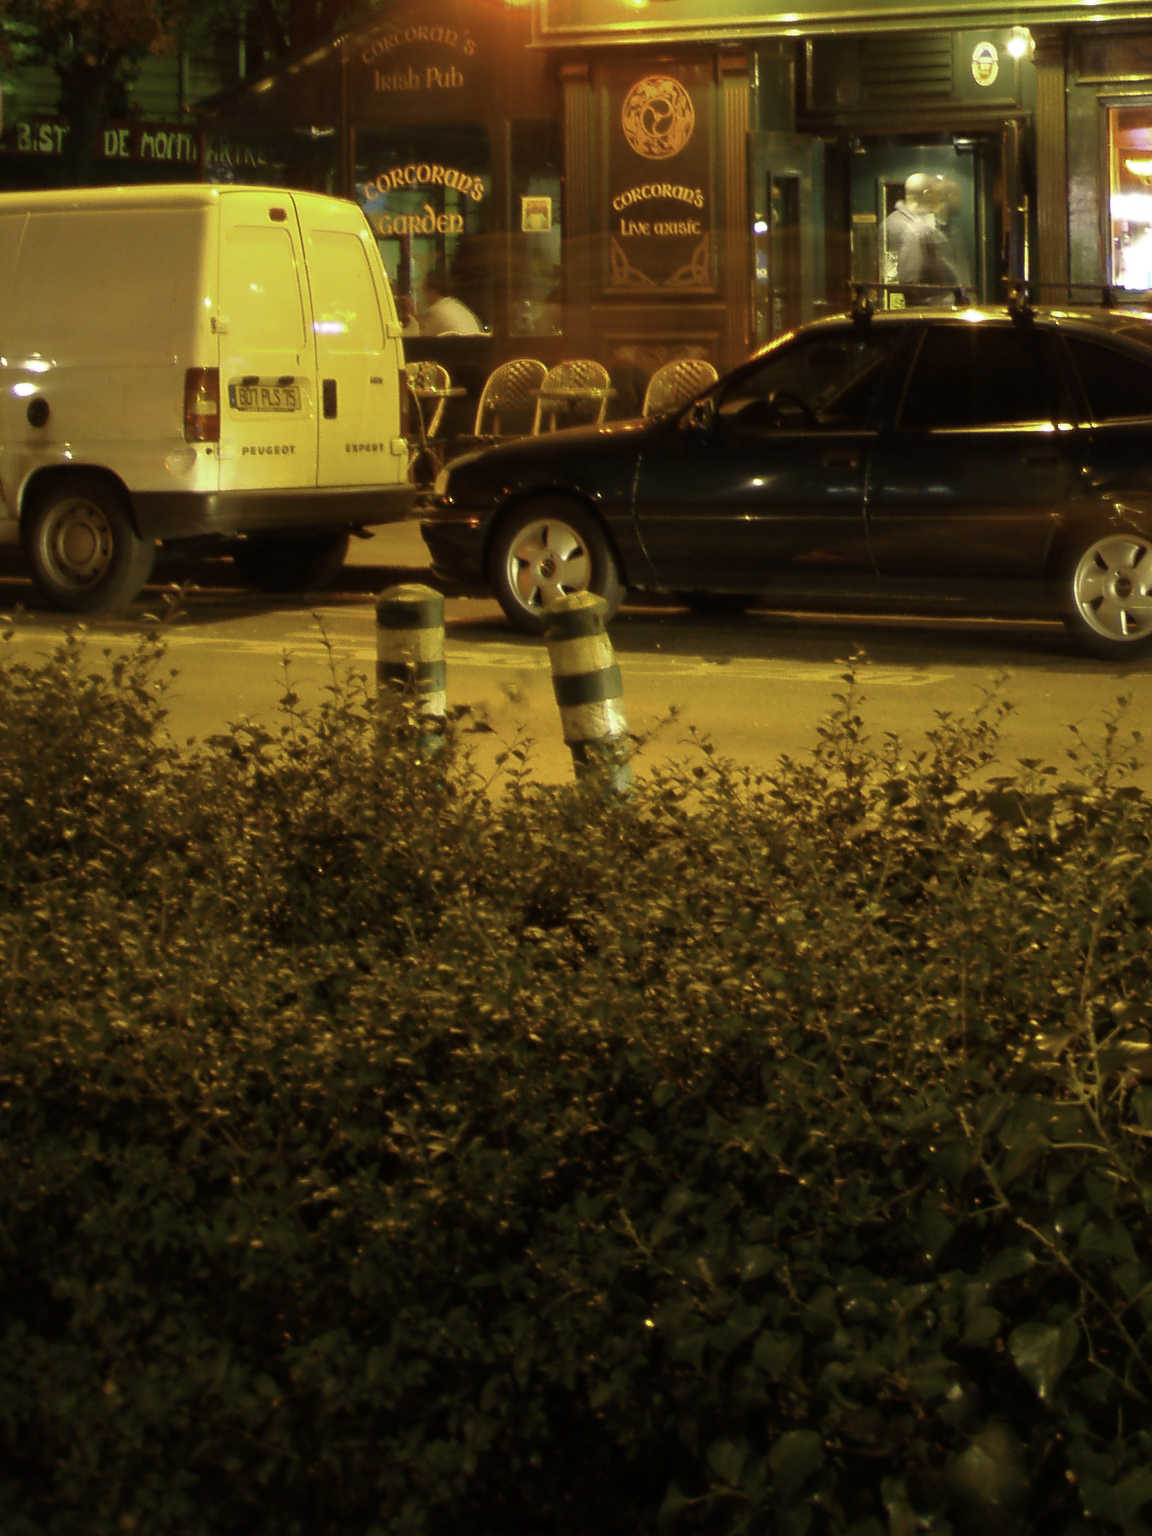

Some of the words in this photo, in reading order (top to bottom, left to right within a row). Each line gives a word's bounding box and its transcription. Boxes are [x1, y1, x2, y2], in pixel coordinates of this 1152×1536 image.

[103, 128, 131, 158] DE
[241, 445, 296, 455] PEUGEOT
[345, 443, 384, 453] EXPERT
